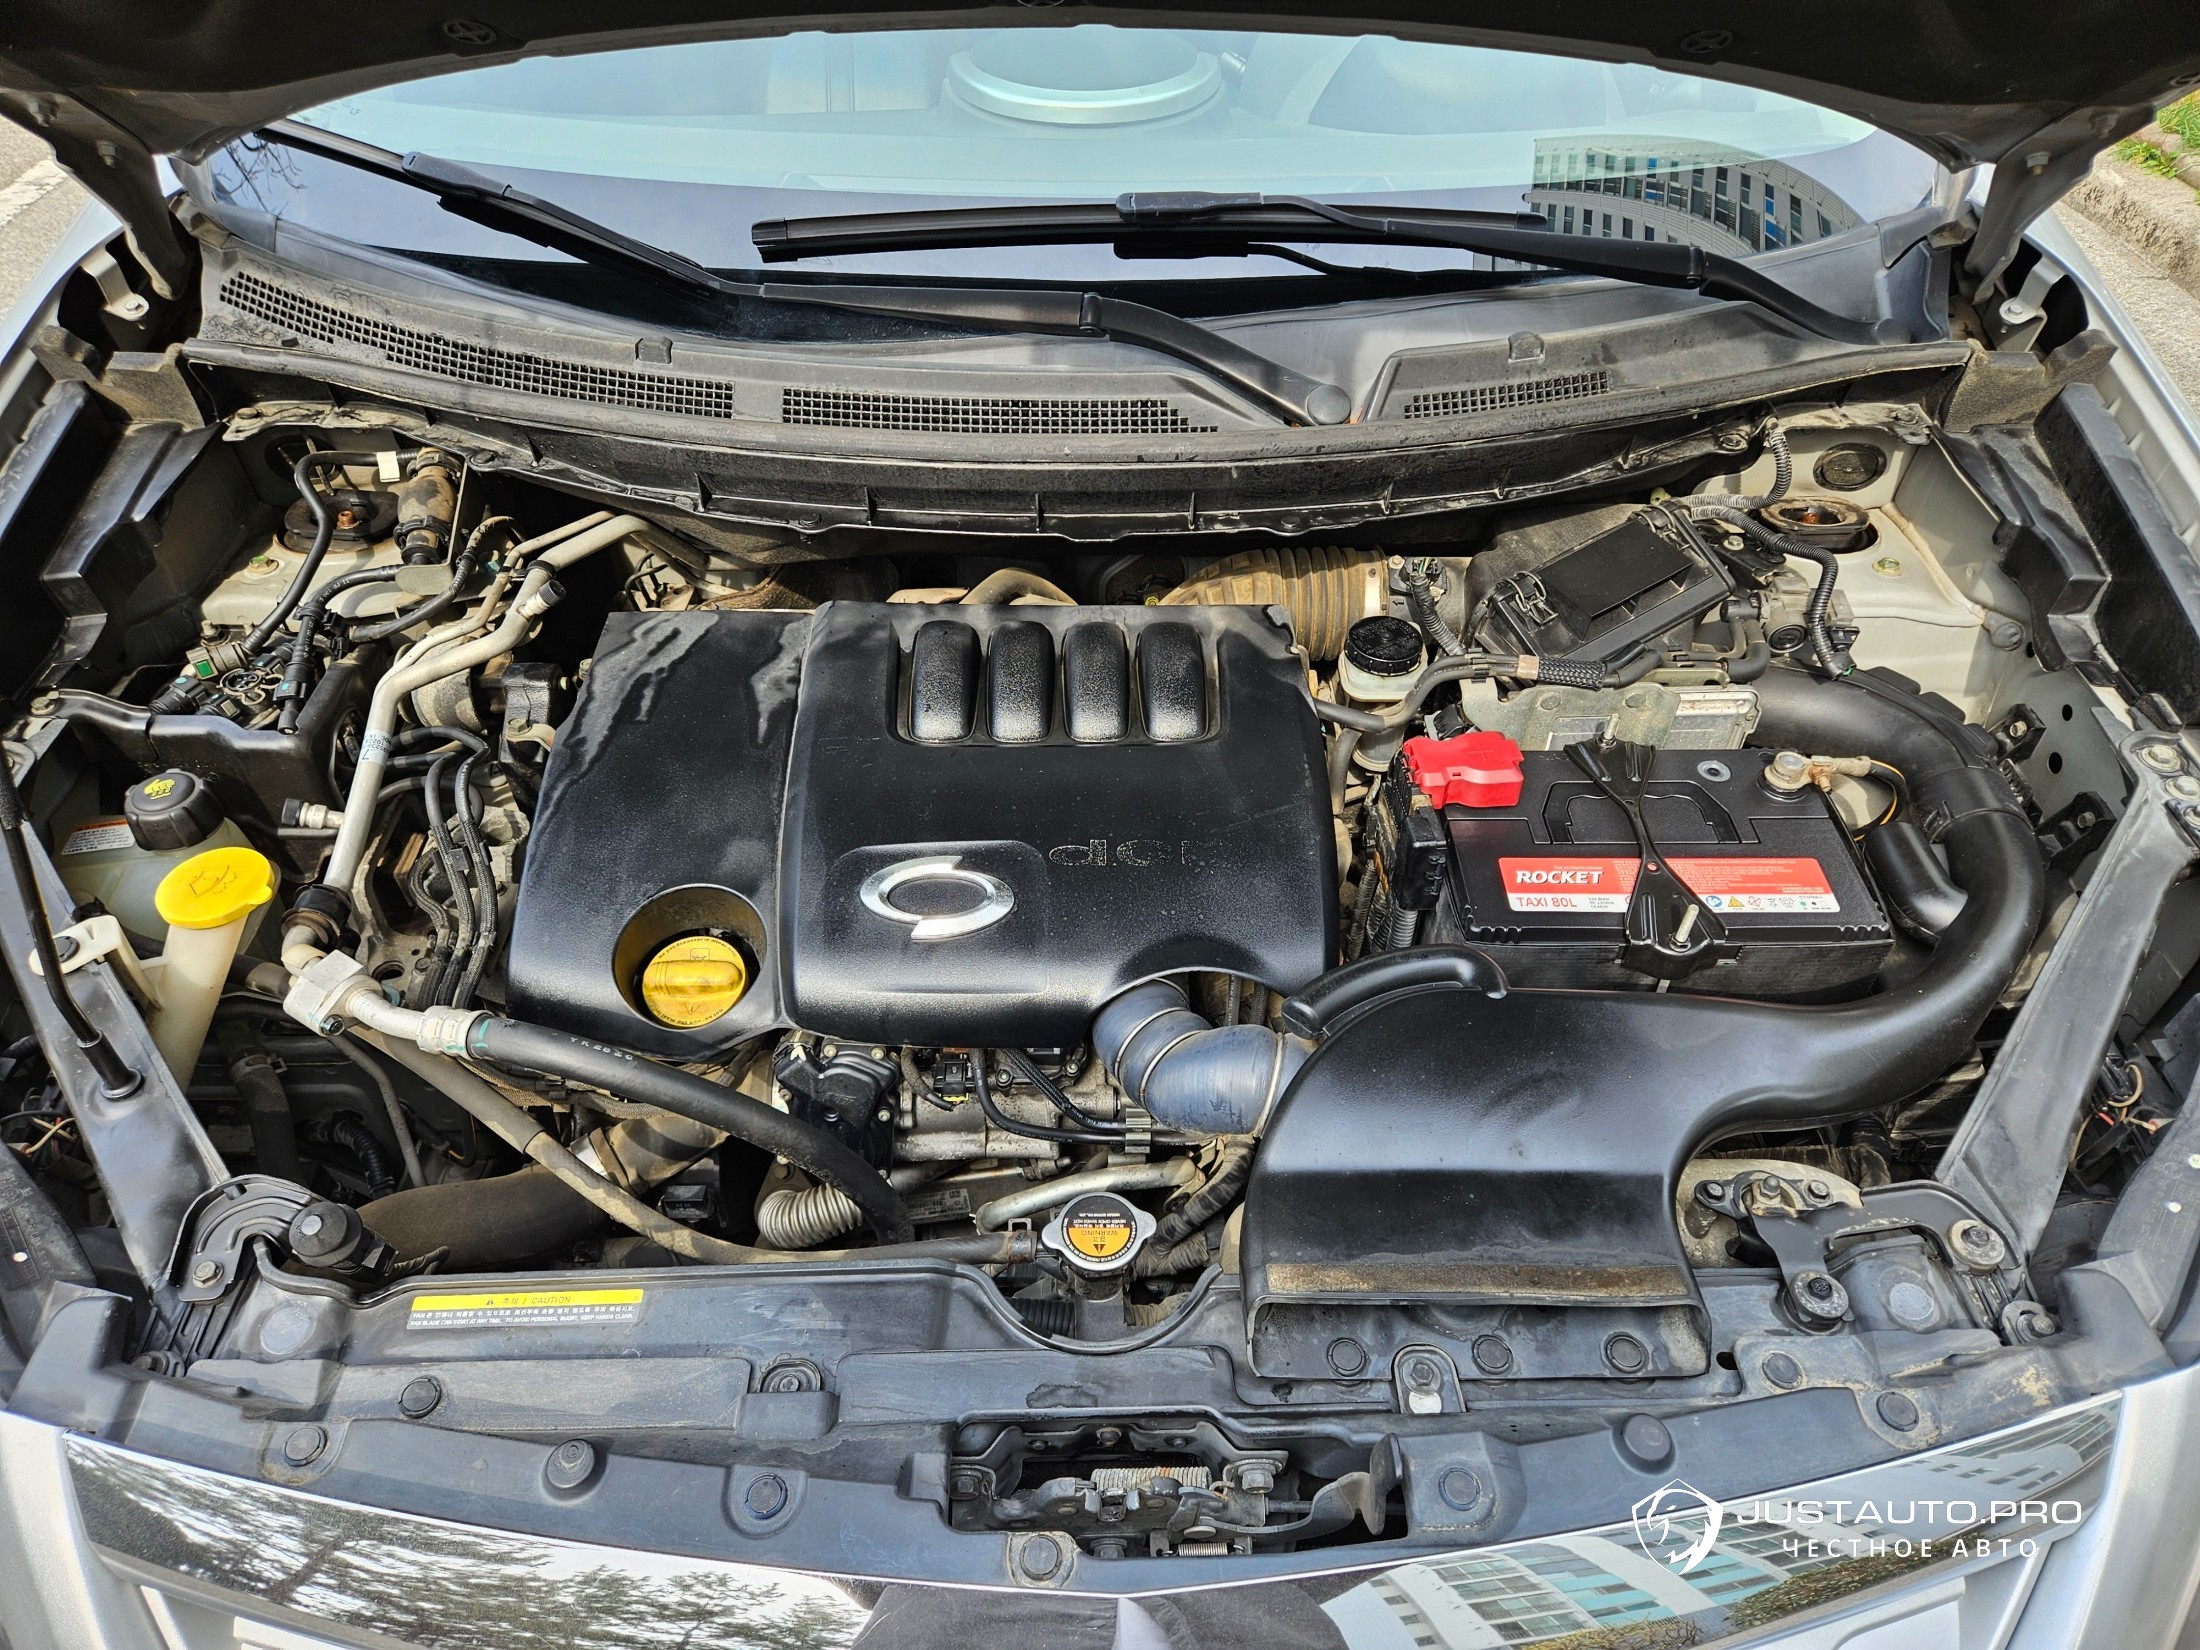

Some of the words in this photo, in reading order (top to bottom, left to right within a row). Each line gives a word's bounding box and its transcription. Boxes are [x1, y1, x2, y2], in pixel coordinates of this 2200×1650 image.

[1516, 870, 1604, 884] ROCKET
[1516, 897, 1548, 907] TAXI
[1552, 897, 1578, 908] 80L
[532, 1296, 570, 1304] CAUTION
